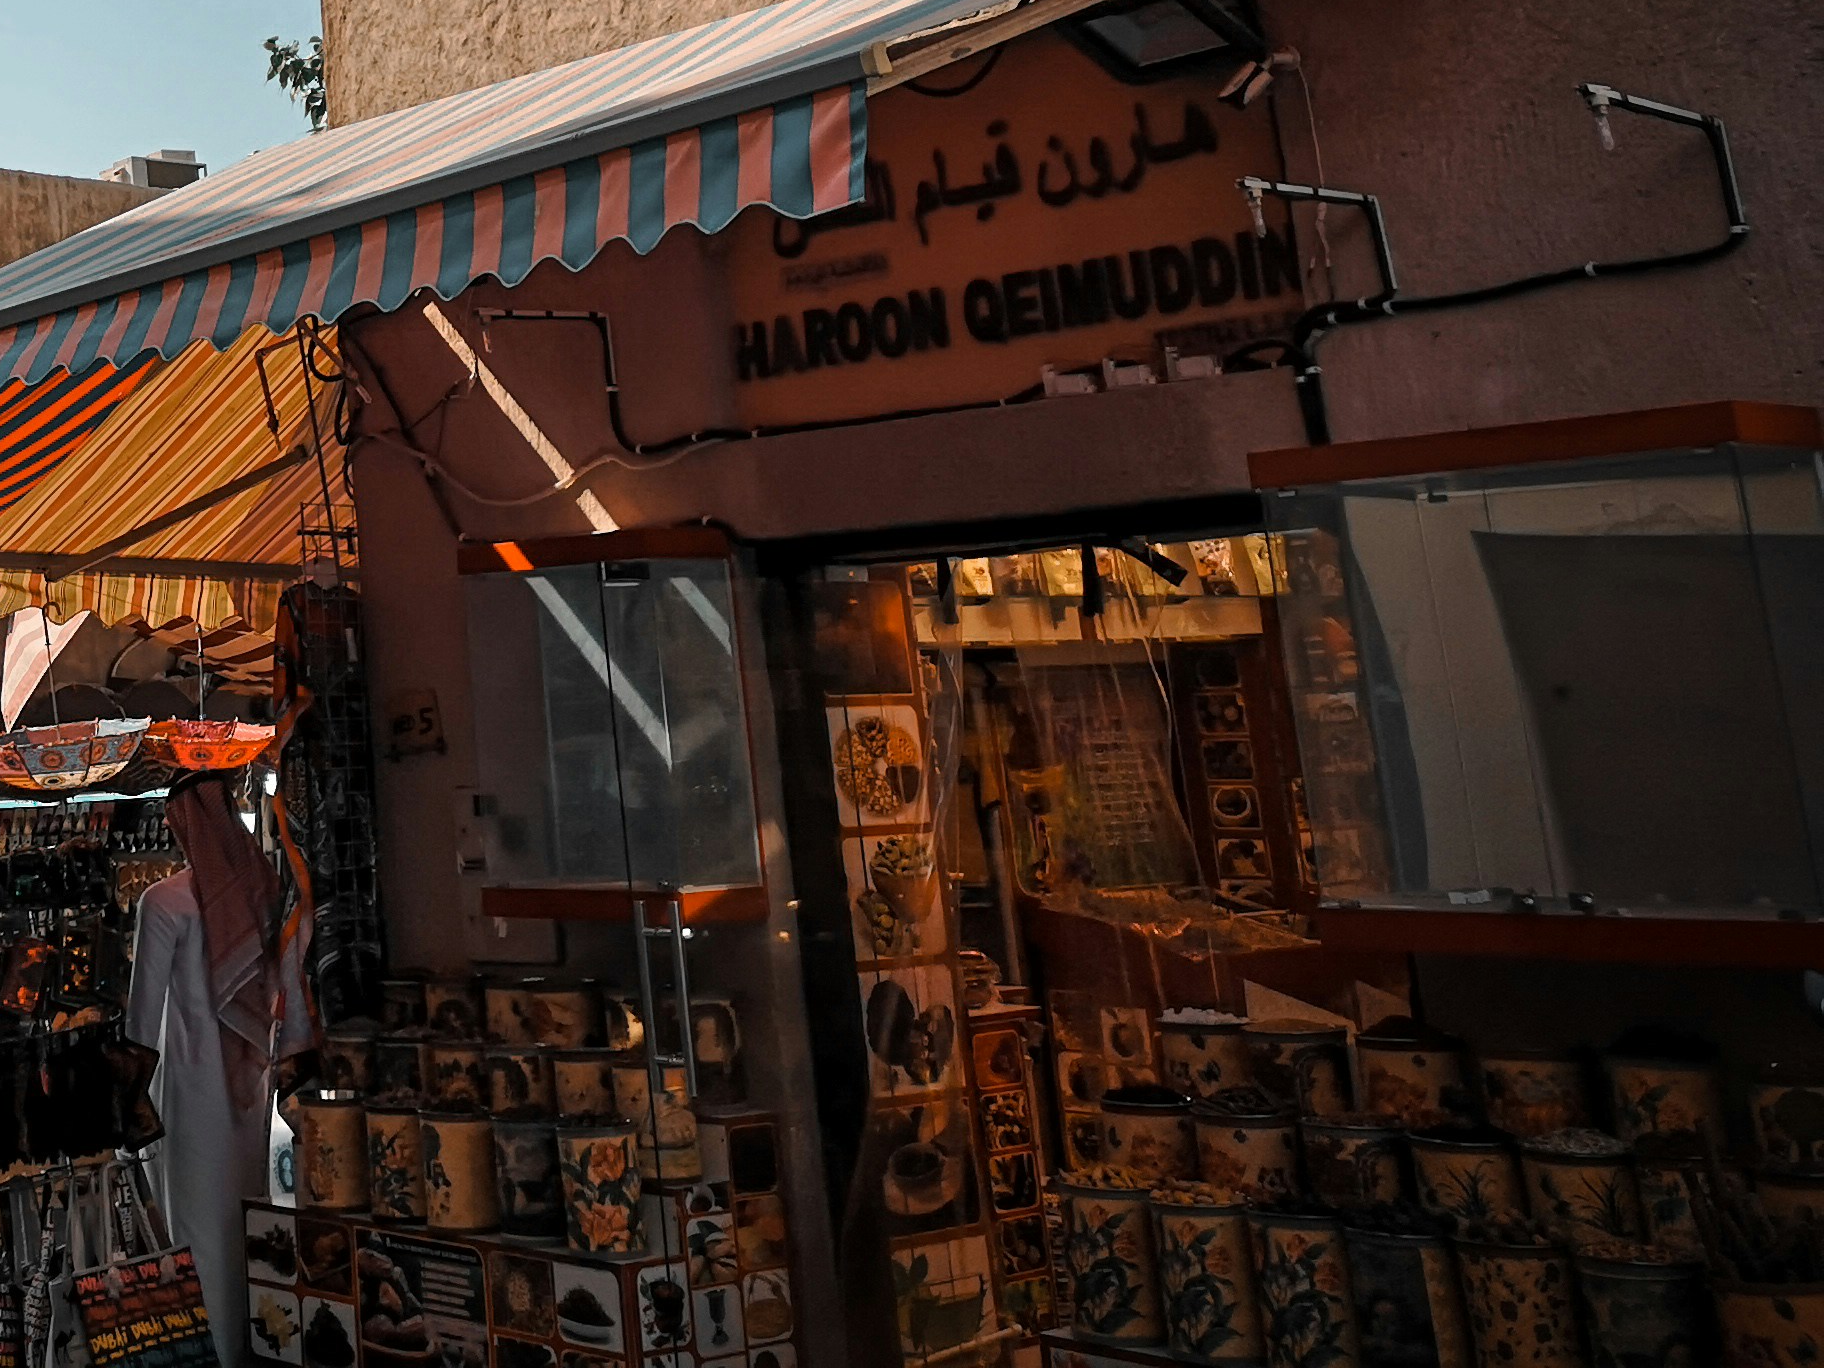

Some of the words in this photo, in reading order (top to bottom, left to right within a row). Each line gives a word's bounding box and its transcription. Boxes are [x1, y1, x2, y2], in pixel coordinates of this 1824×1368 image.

[1038, 102, 1217, 205] هارون
[736, 287, 950, 381] HAROON
[964, 222, 1304, 343] QEIMUDDIN
